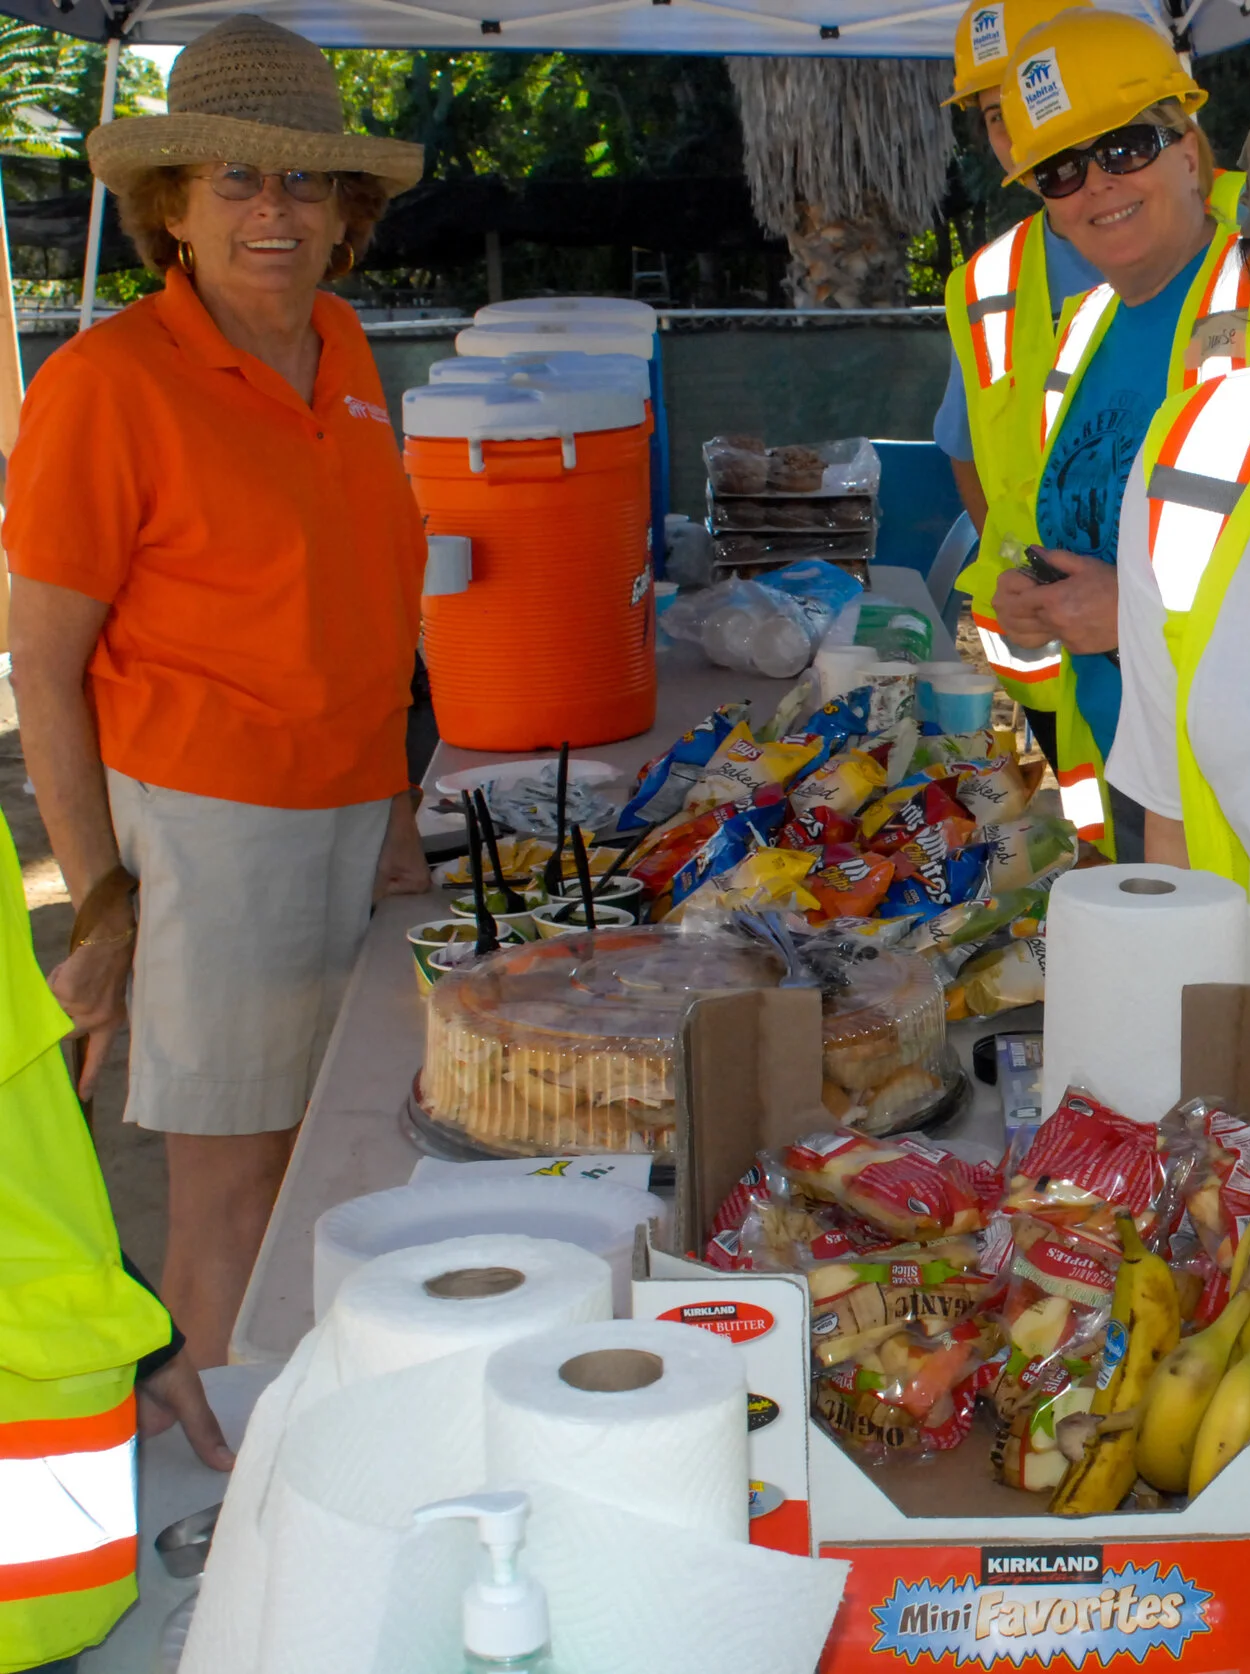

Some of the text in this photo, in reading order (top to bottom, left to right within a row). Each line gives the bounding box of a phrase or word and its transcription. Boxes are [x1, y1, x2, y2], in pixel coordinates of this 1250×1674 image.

[1025, 81, 1057, 105] Habitat
[1046, 1247, 1099, 1270] APPLES
[892, 1264, 920, 1279] Slice
[683, 1305, 736, 1318] KIRKLAND
[894, 1291, 976, 1322] GANIC
[716, 1319, 766, 1333] BUTTER
[987, 1556, 1099, 1573] KIRKLAND
[898, 1583, 1186, 1641] Mini Favorites
